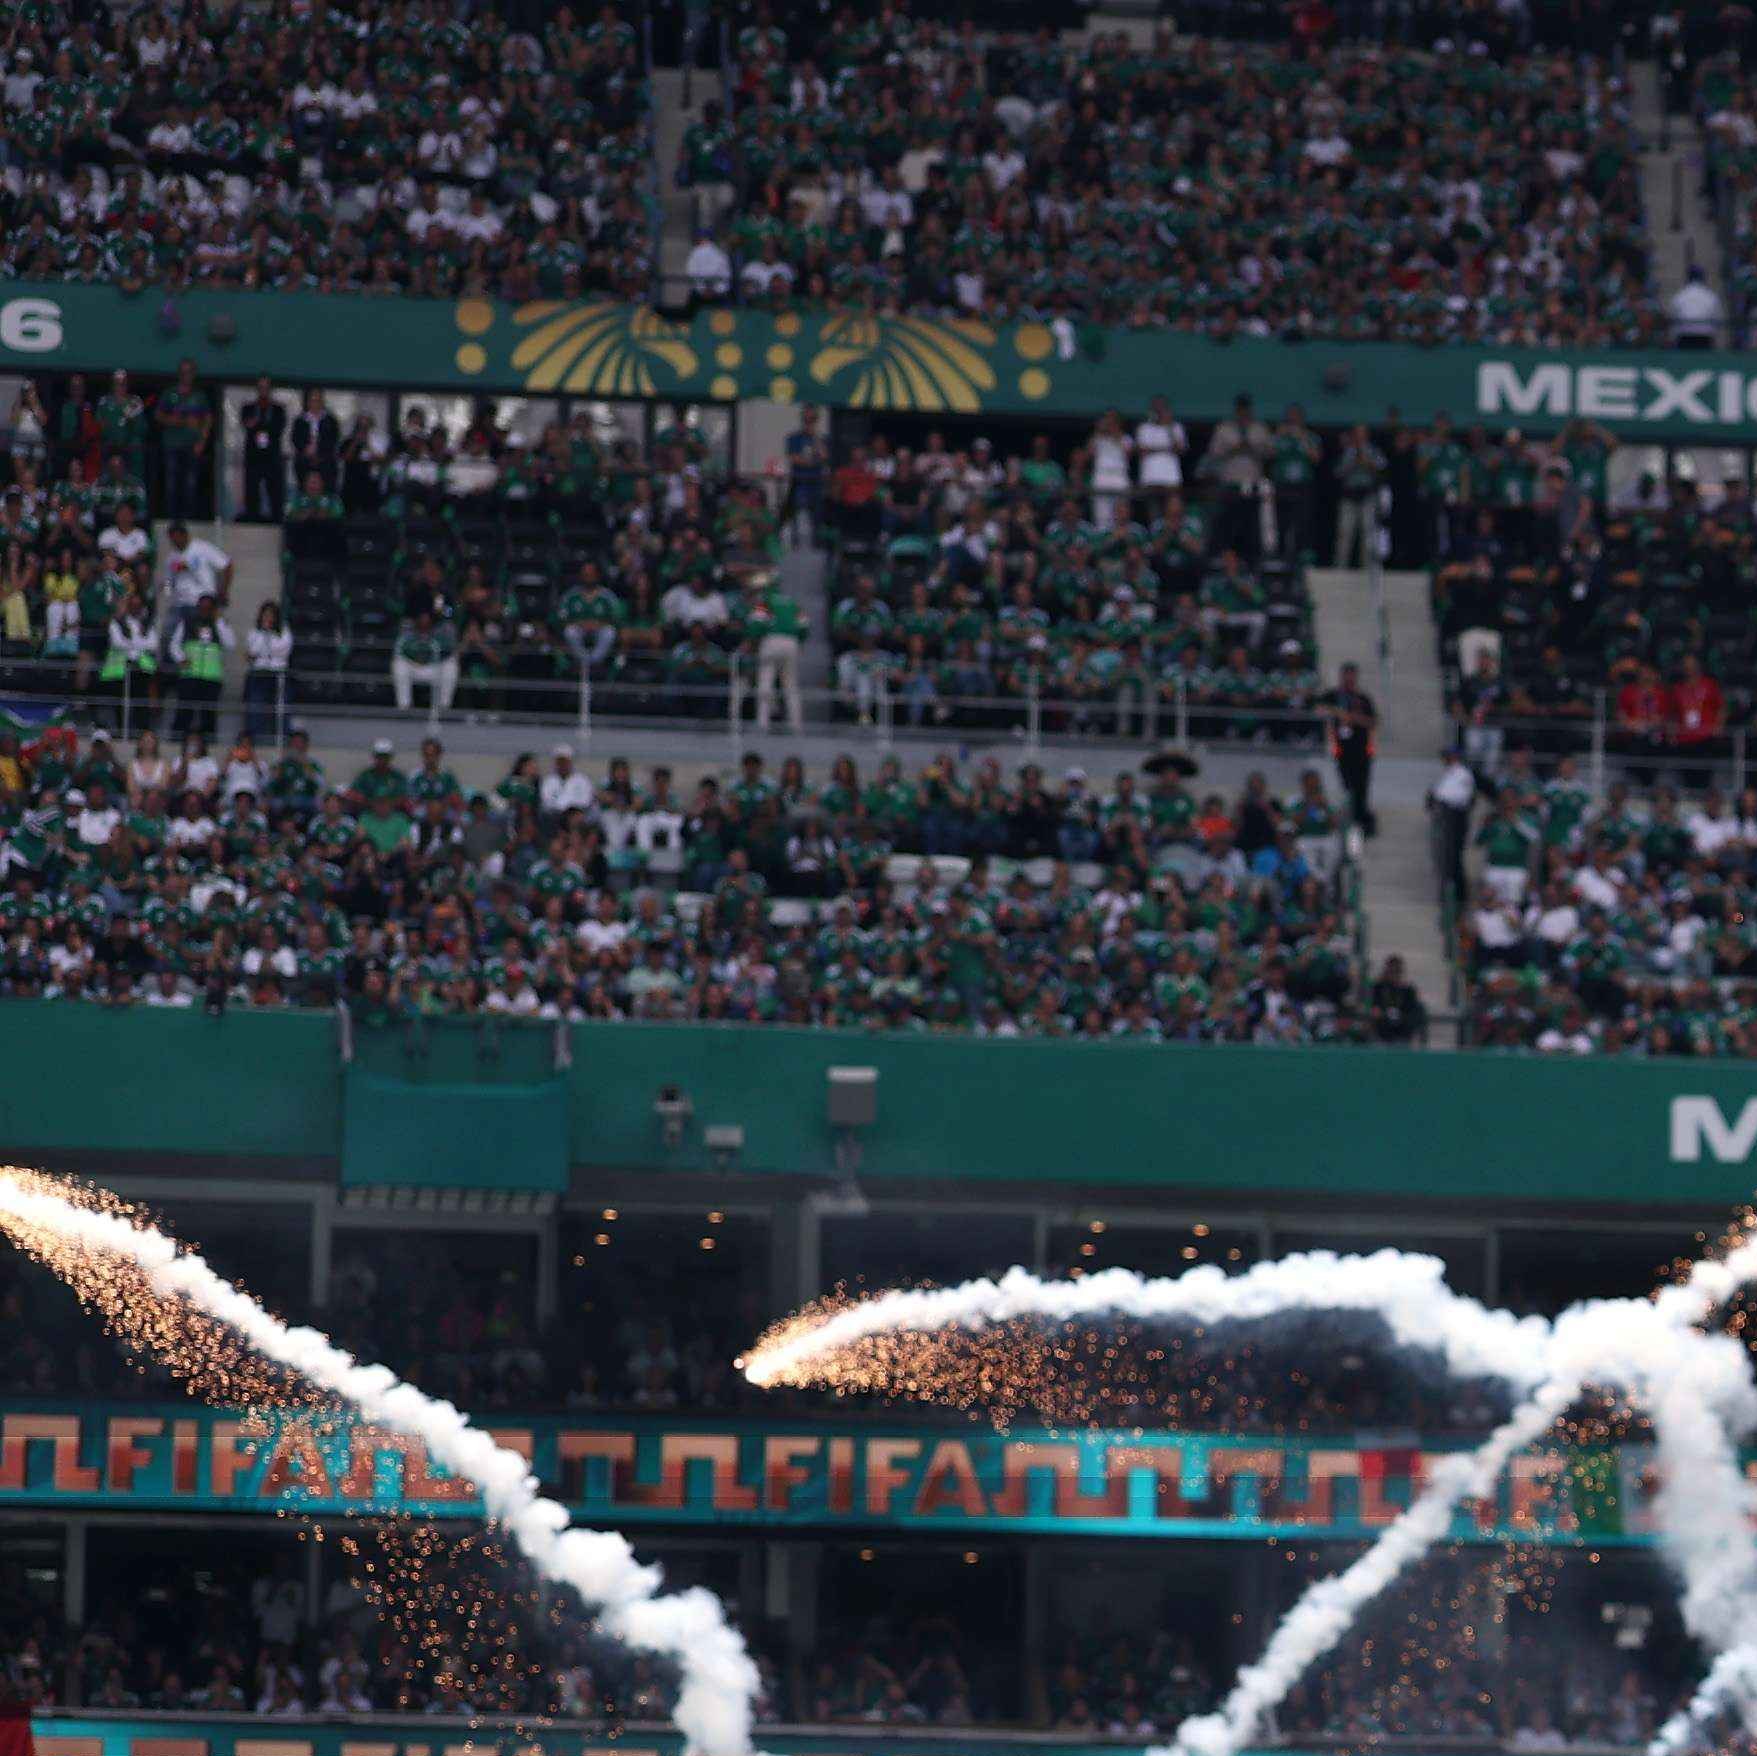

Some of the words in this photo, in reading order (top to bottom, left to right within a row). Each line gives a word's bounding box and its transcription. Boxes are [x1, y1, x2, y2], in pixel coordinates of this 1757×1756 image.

[0, 298, 63, 352] 6
[108, 1418, 334, 1498] FIFA
[766, 1436, 986, 1517] FIFA
